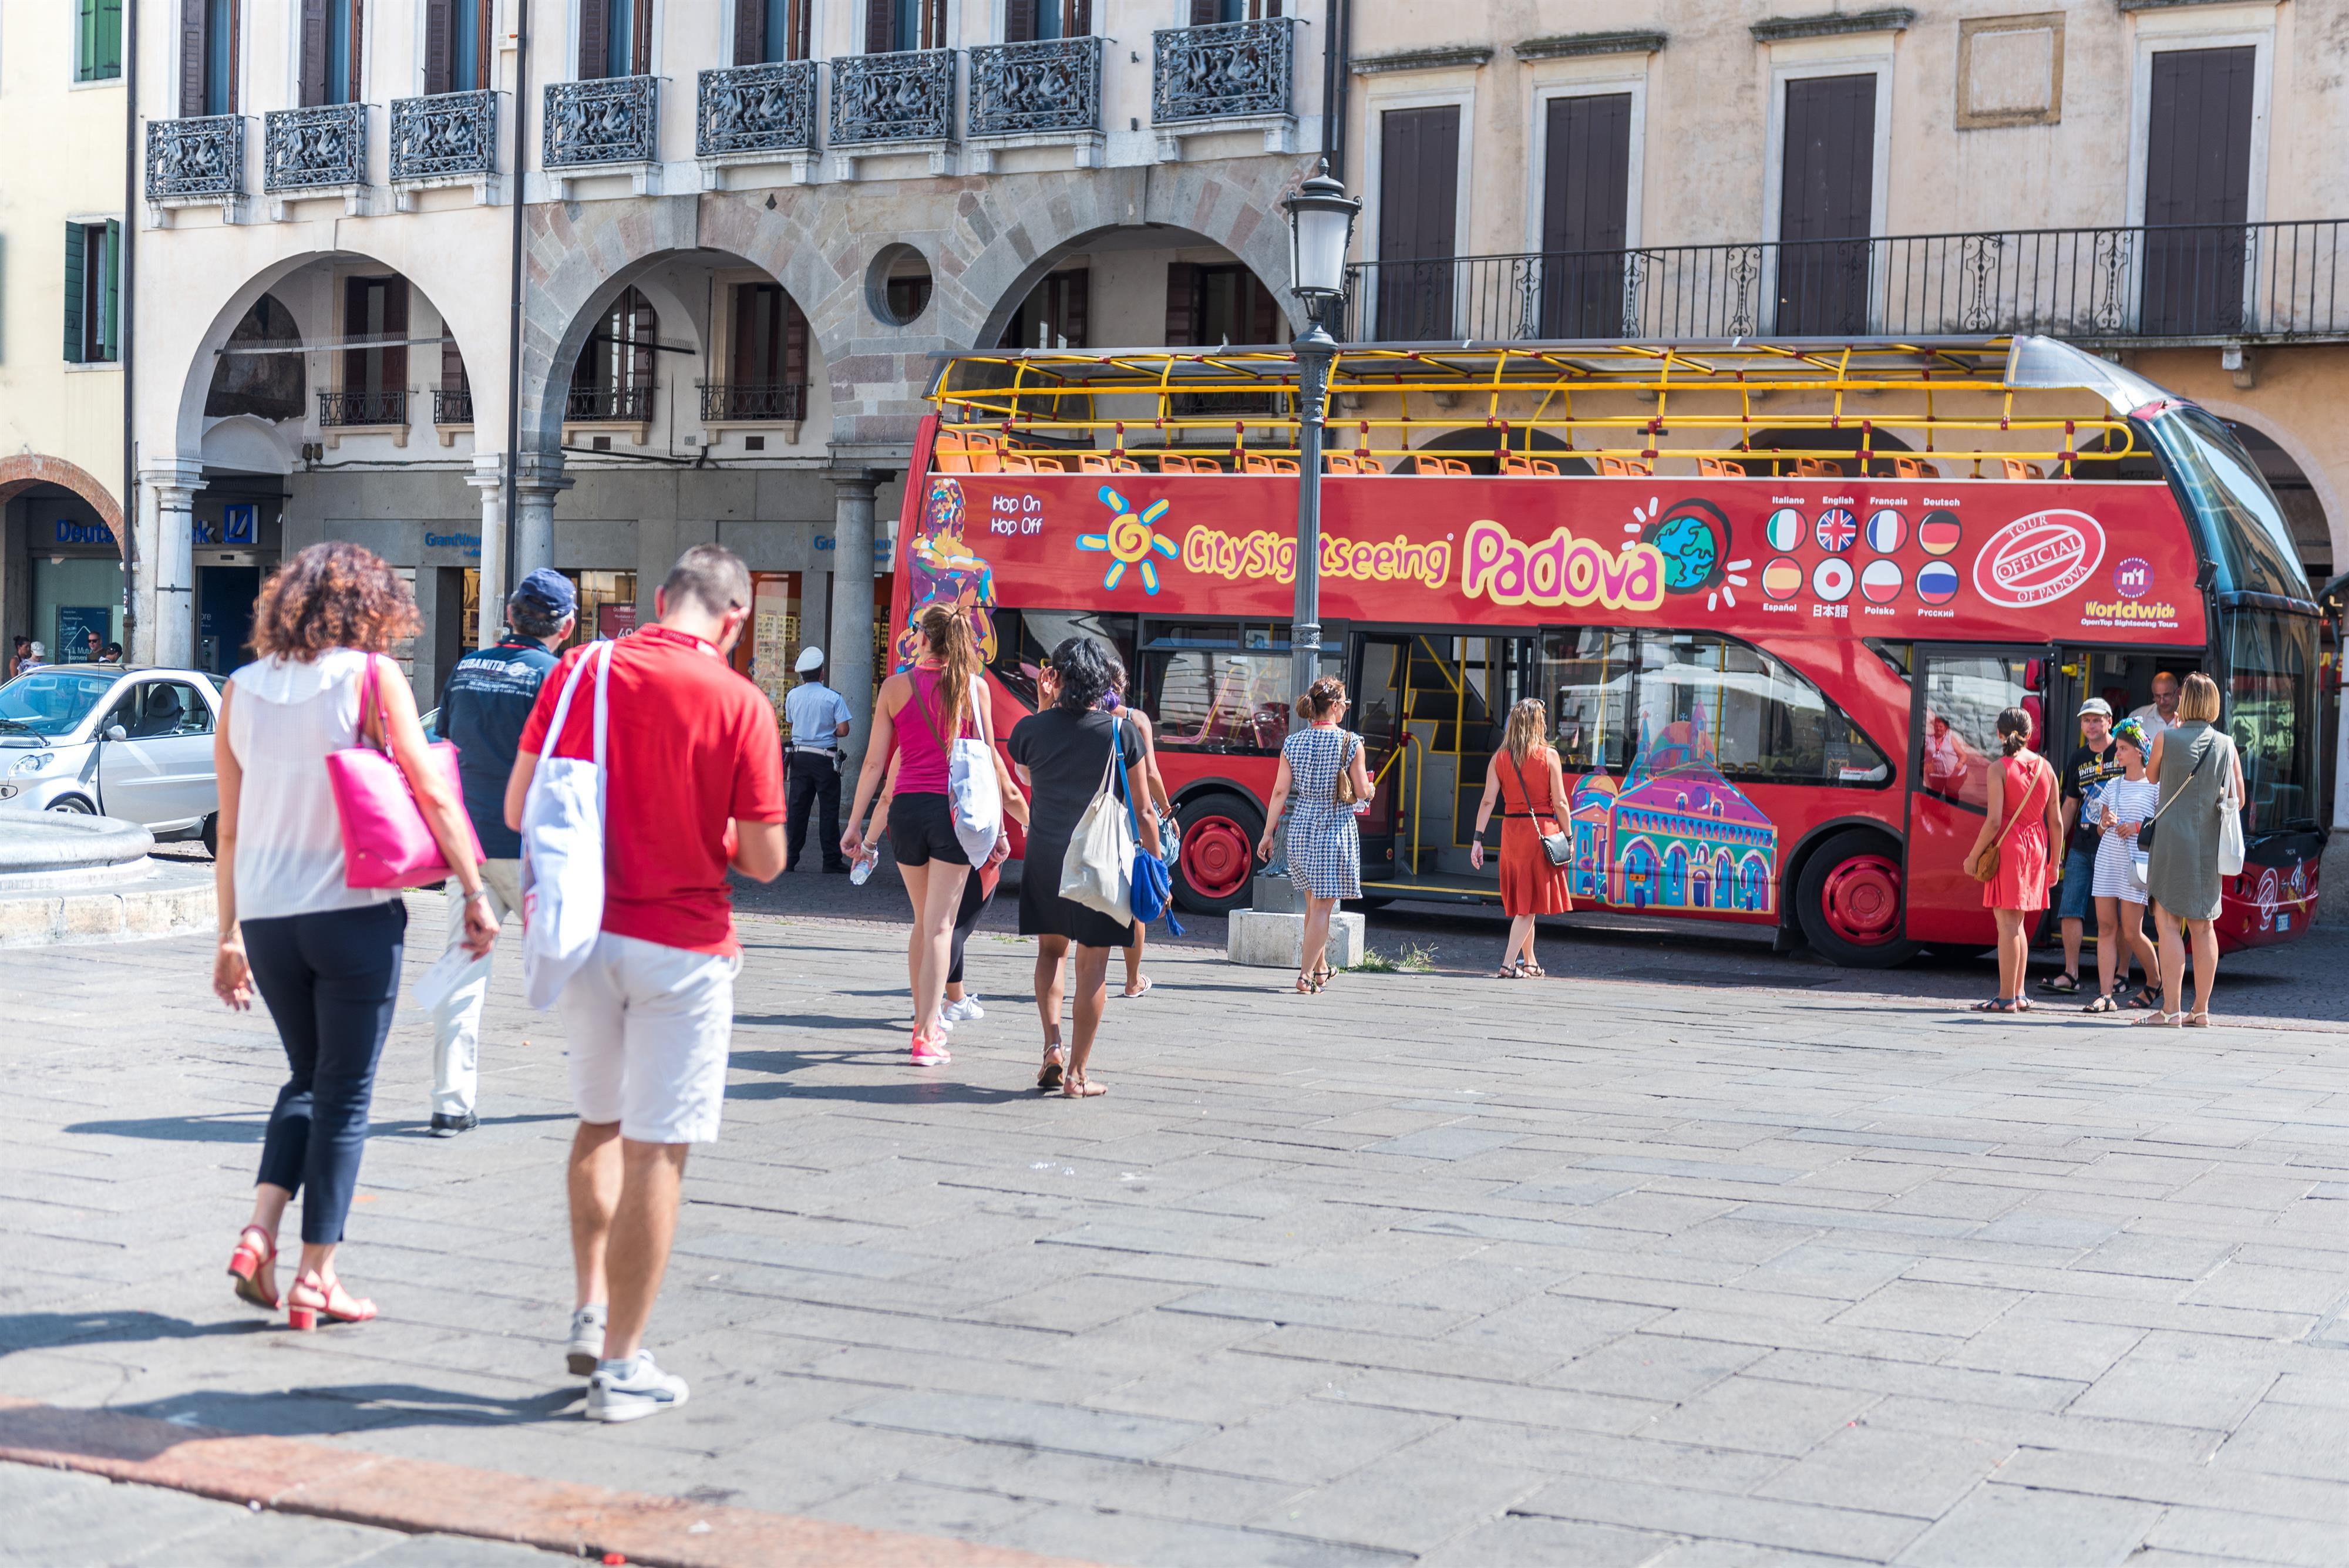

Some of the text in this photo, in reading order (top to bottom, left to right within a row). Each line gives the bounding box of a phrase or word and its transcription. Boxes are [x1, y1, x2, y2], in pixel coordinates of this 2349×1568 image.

[992, 494, 1041, 513] Hop On
[1772, 496, 1805, 504] Italiano
[1822, 496, 1855, 506] English
[1870, 497, 1908, 506] Français
[1923, 497, 1960, 507] Deutsch
[56, 519, 115, 543] Deuts
[991, 517, 1042, 536] Hop Off
[2006, 516, 2048, 539] TOUR
[1997, 536, 2081, 580] OFFICIAL
[1183, 520, 1665, 611] CitySigtseeing Padova
[2017, 564, 2088, 603] OF PADOVA
[1762, 603, 1797, 612] Español
[1812, 604, 1849, 618] 日本語
[1917, 608, 1954, 617] Русский
[2085, 600, 2175, 619] Worldwide
[2081, 618, 2178, 628] OpenTop Sightseeing Tours
[457, 658, 506, 671] CUBANITO
